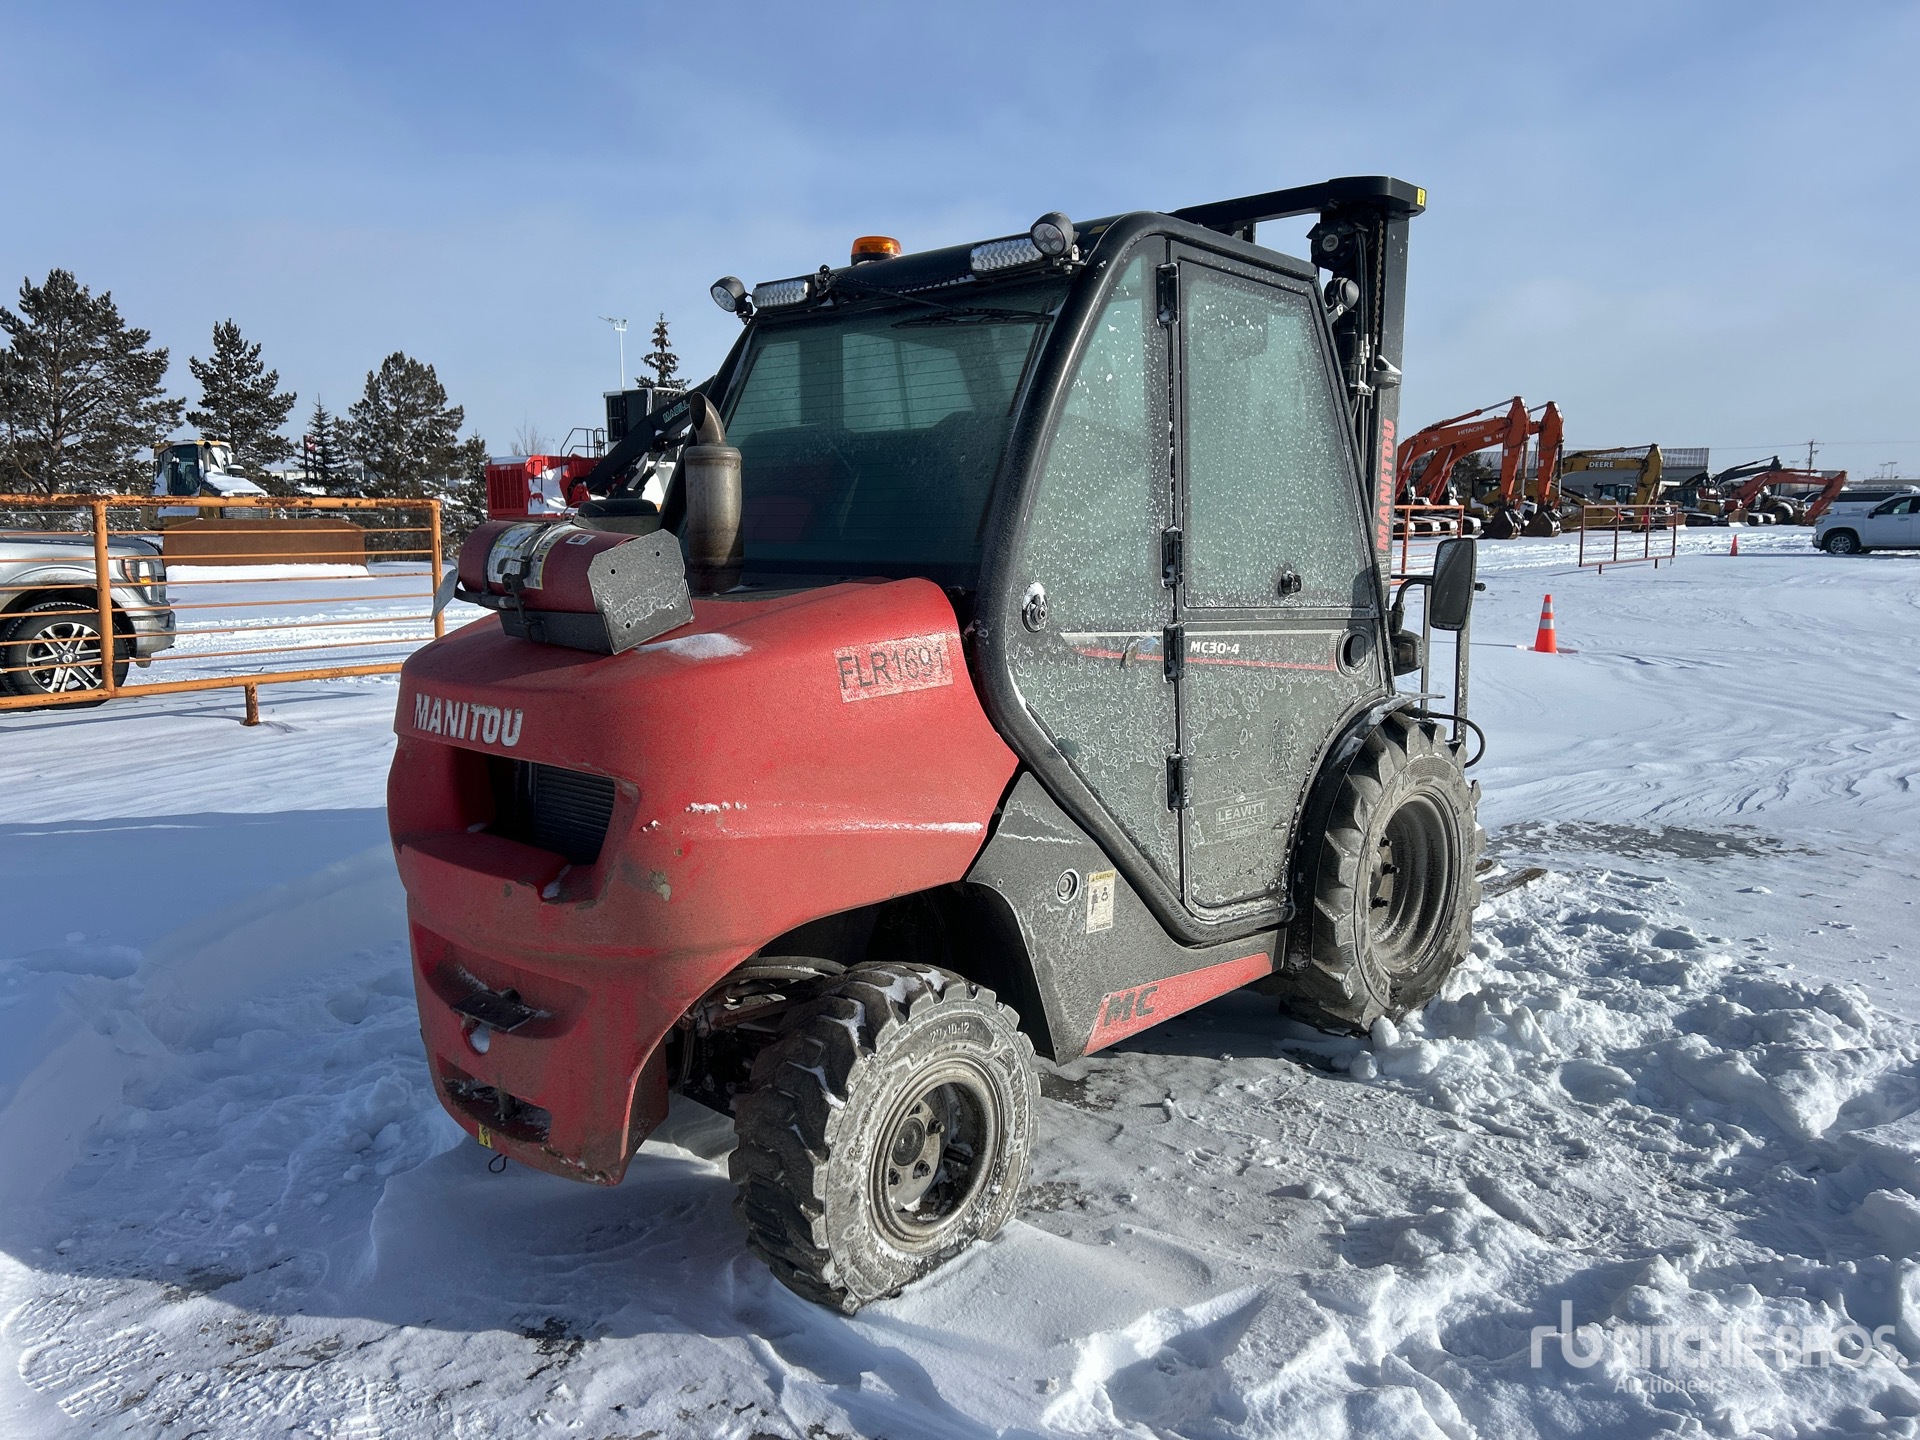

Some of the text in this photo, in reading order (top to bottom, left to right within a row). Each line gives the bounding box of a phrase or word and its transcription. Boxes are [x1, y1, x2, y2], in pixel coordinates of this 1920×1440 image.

[1457, 425, 1485, 436] HITACHI
[1376, 418, 1395, 551] MANITOU
[837, 646, 945, 690] FLR1691
[1190, 641, 1240, 655] MC30-4
[413, 692, 524, 747] MANITOU
[1218, 801, 1266, 822] LEAVITT
[1103, 984, 1159, 1027] MC
